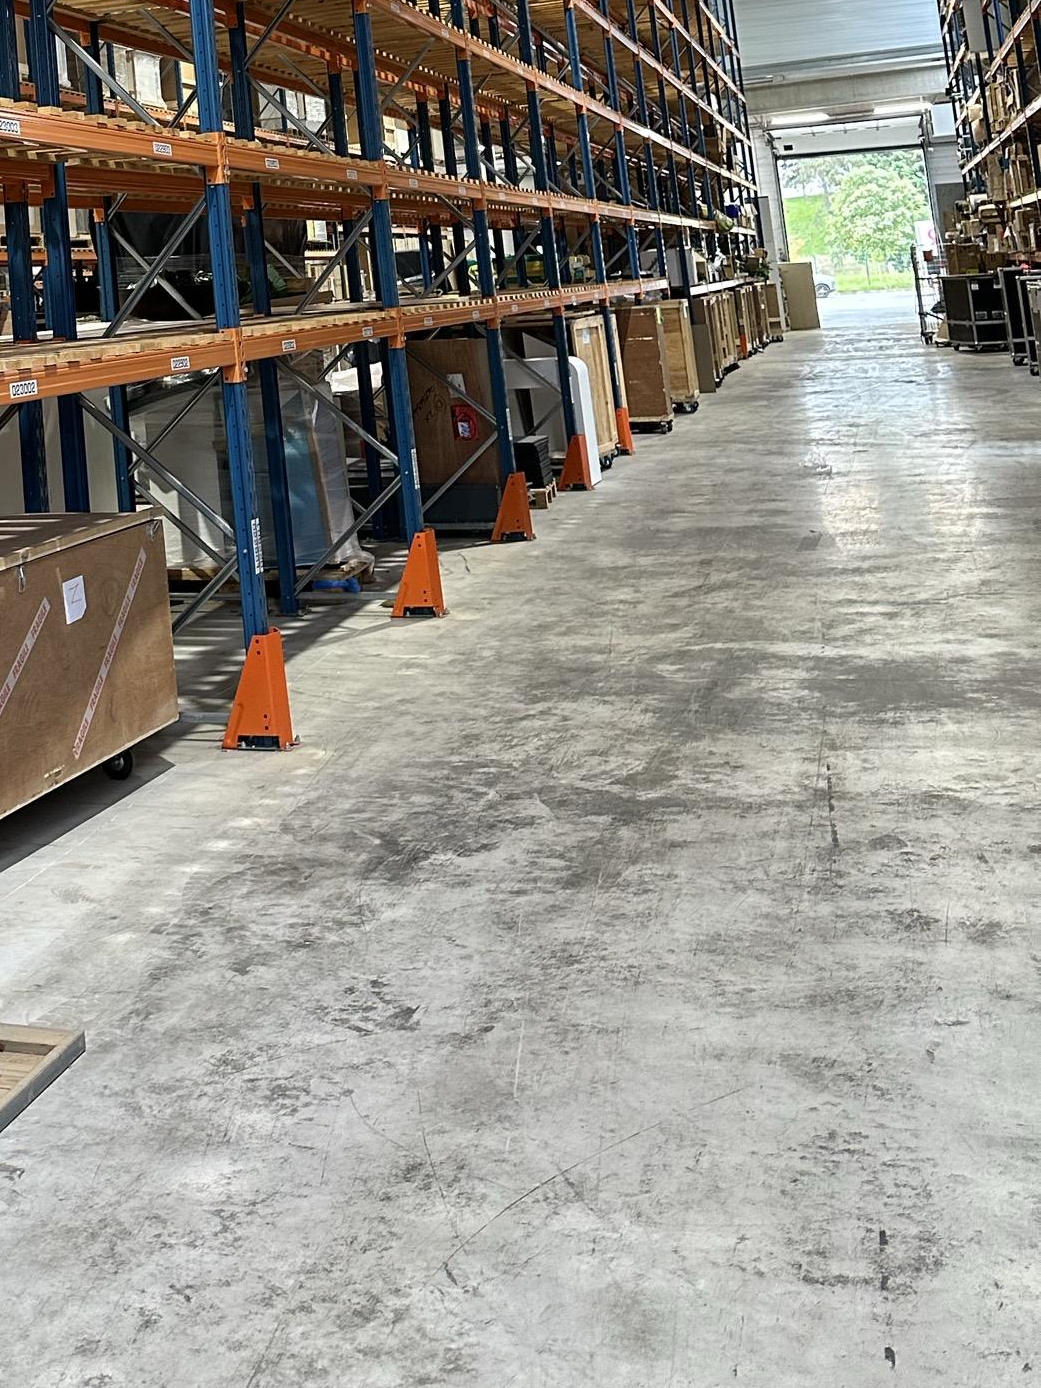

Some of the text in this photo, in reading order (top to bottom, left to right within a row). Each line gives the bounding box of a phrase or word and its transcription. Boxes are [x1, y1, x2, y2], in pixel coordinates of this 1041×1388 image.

[12, 642, 30, 680] FRAGILE
[30, 603, 48, 640] FRAGILE
[89, 675, 104, 711] FRAGILE
[103, 633, 117, 669] FRAGILE
[116, 595, 131, 629] FRAGILE
